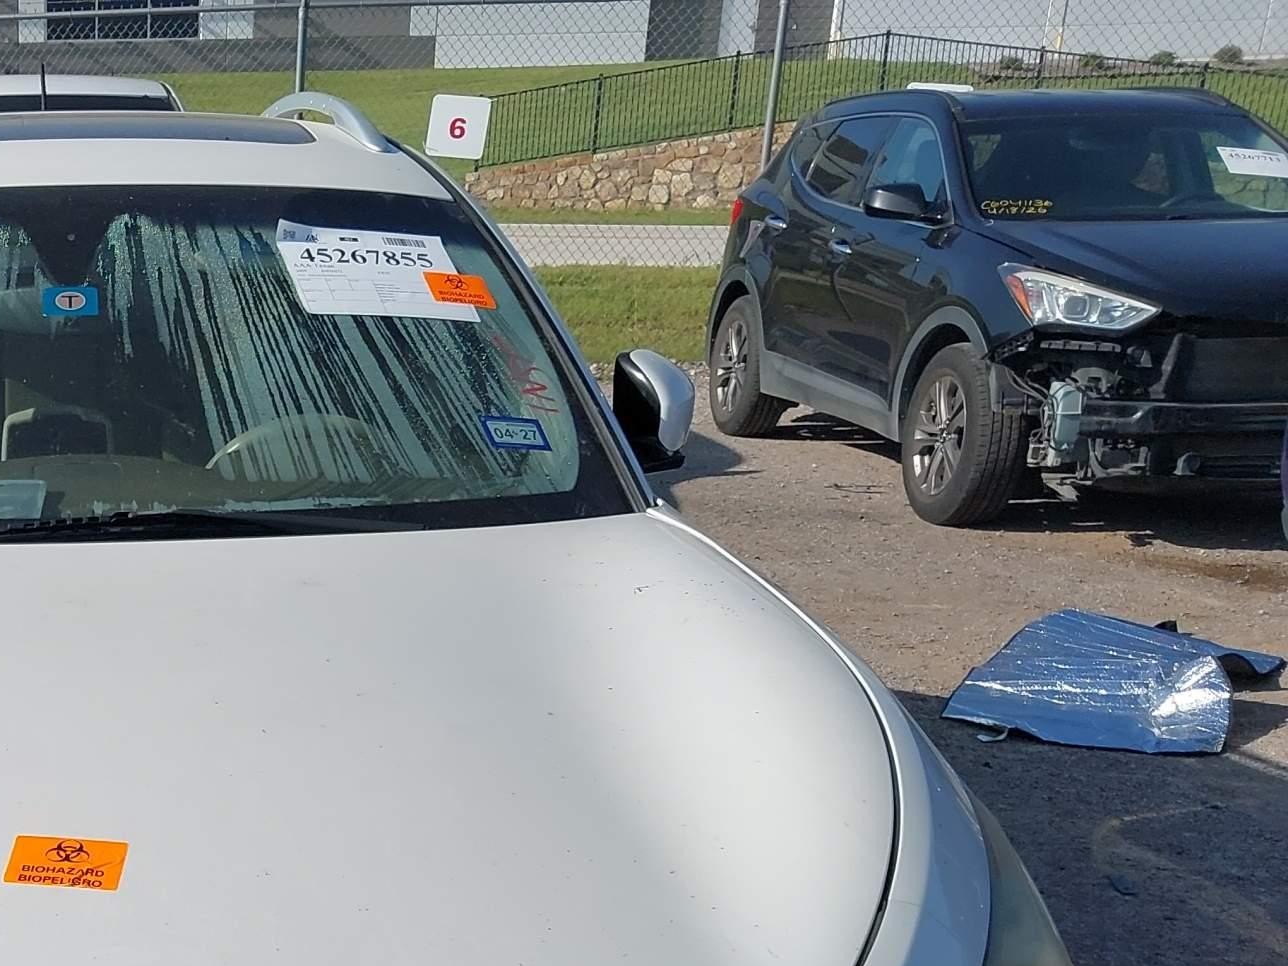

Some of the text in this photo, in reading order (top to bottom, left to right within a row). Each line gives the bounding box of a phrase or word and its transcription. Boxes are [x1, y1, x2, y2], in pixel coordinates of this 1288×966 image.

[449, 117, 467, 139] 6
[300, 247, 433, 268] 45267855
[21, 864, 104, 878] BIOHAZARD
[17, 873, 103, 888] BIOPELIGRO
